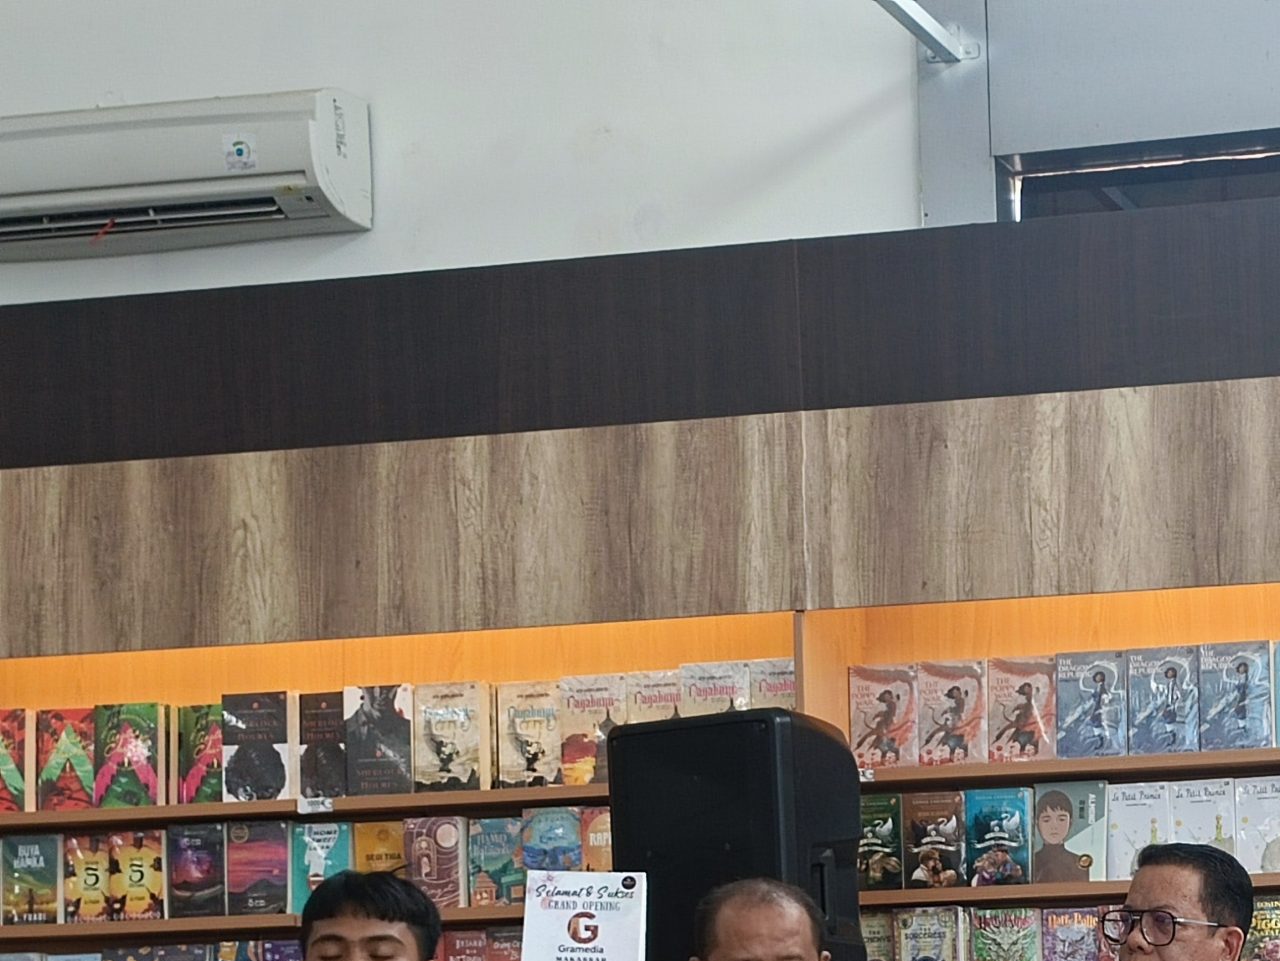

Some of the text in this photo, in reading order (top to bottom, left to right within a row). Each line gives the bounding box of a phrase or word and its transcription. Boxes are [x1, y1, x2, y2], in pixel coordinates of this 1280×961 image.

[18, 844, 41, 857] BUYA
[14, 856, 46, 869] HAMKA
[535, 883, 584, 898] Selamat
[597, 885, 635, 900] Sukses
[548, 900, 622, 912] GRAND OPENING
[558, 944, 605, 954] Gramedia
